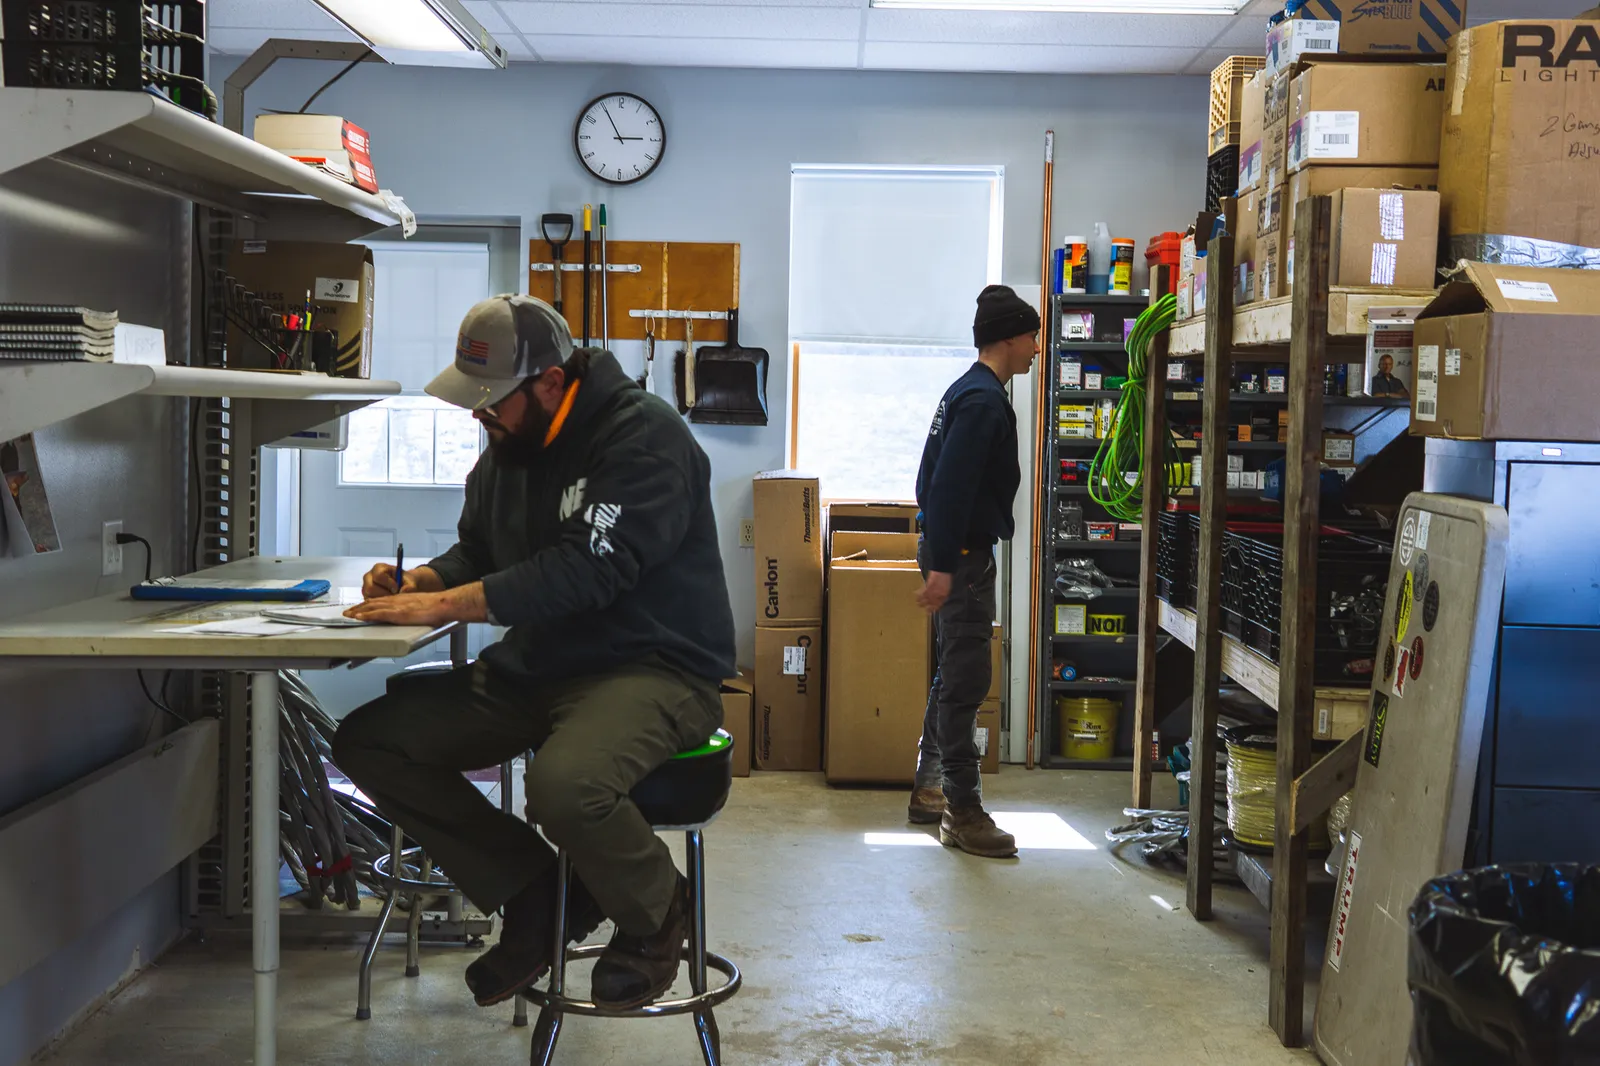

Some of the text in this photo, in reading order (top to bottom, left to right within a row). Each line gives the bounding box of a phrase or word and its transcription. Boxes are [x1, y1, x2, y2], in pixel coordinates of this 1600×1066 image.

[618, 96, 625, 109] 12
[764, 557, 780, 619] Carlon
[1335, 847, 1358, 957] TRUMP
